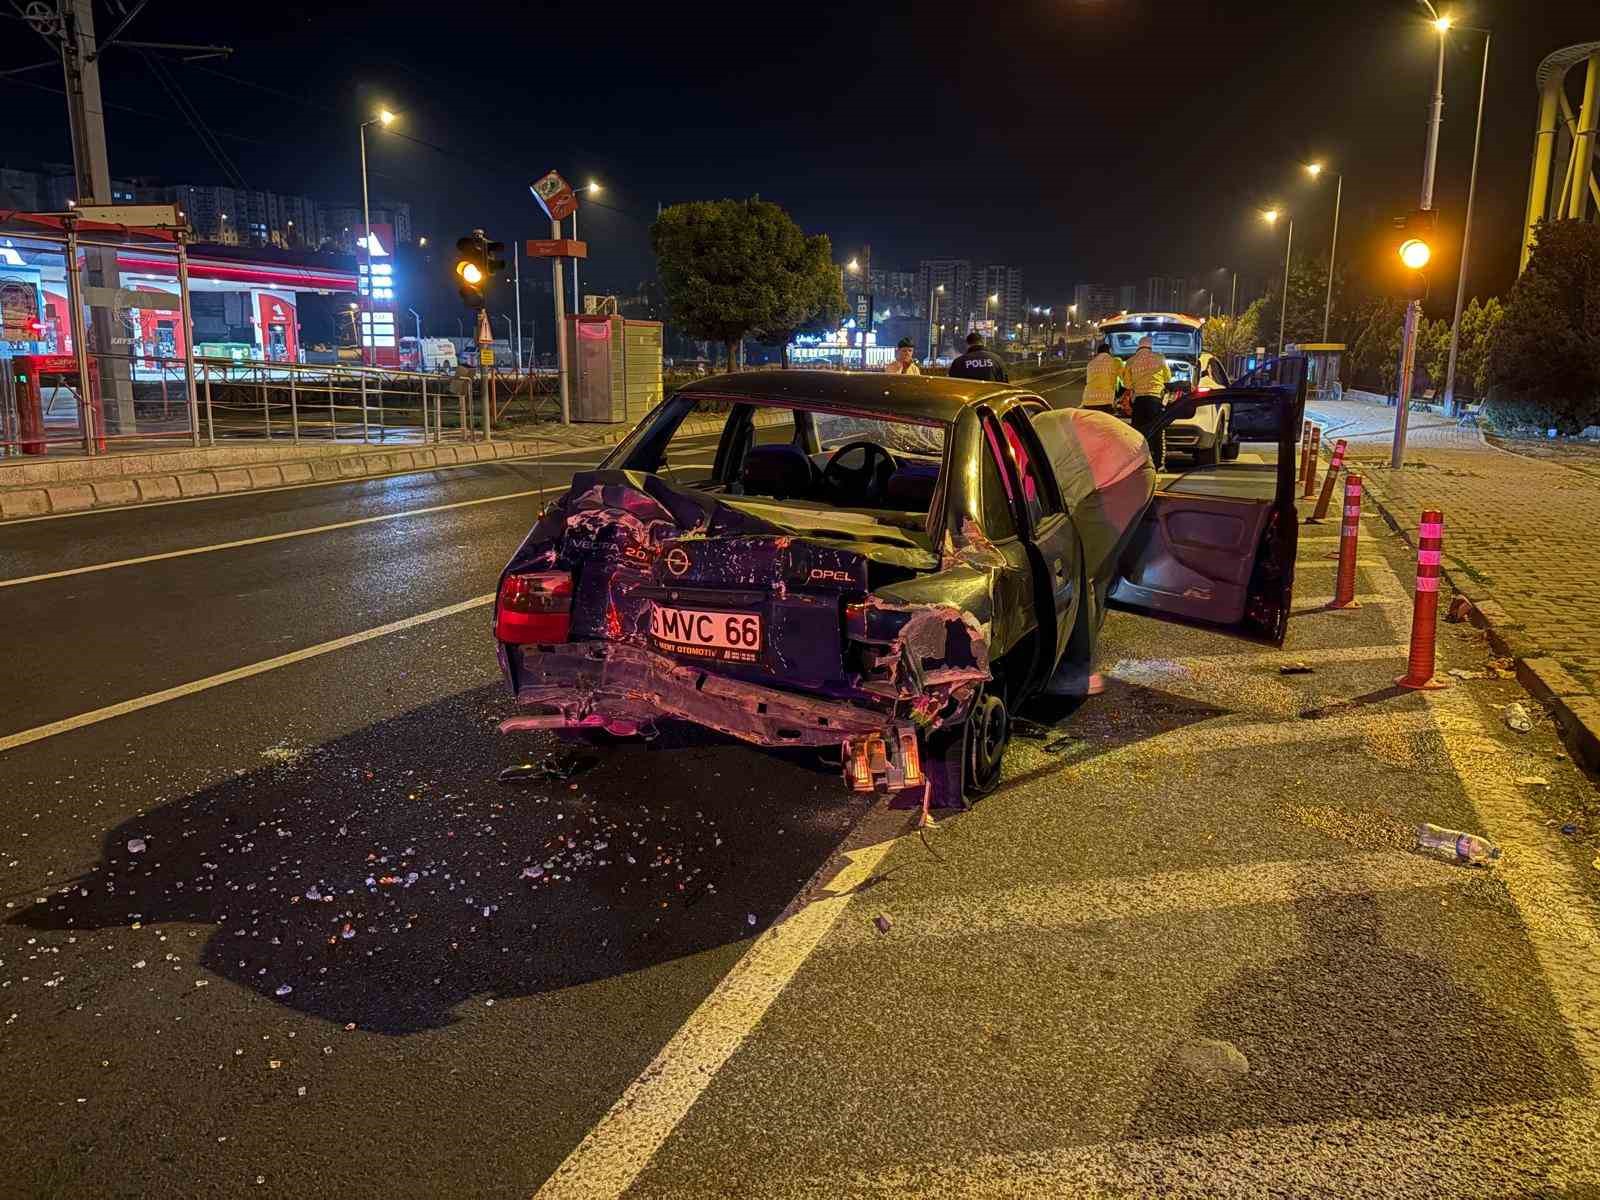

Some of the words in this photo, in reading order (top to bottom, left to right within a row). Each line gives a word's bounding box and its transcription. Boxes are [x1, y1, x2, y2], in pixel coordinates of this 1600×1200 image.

[811, 569, 851, 582] OPEL
[662, 610, 714, 642] MVC
[725, 617, 758, 646] 66
